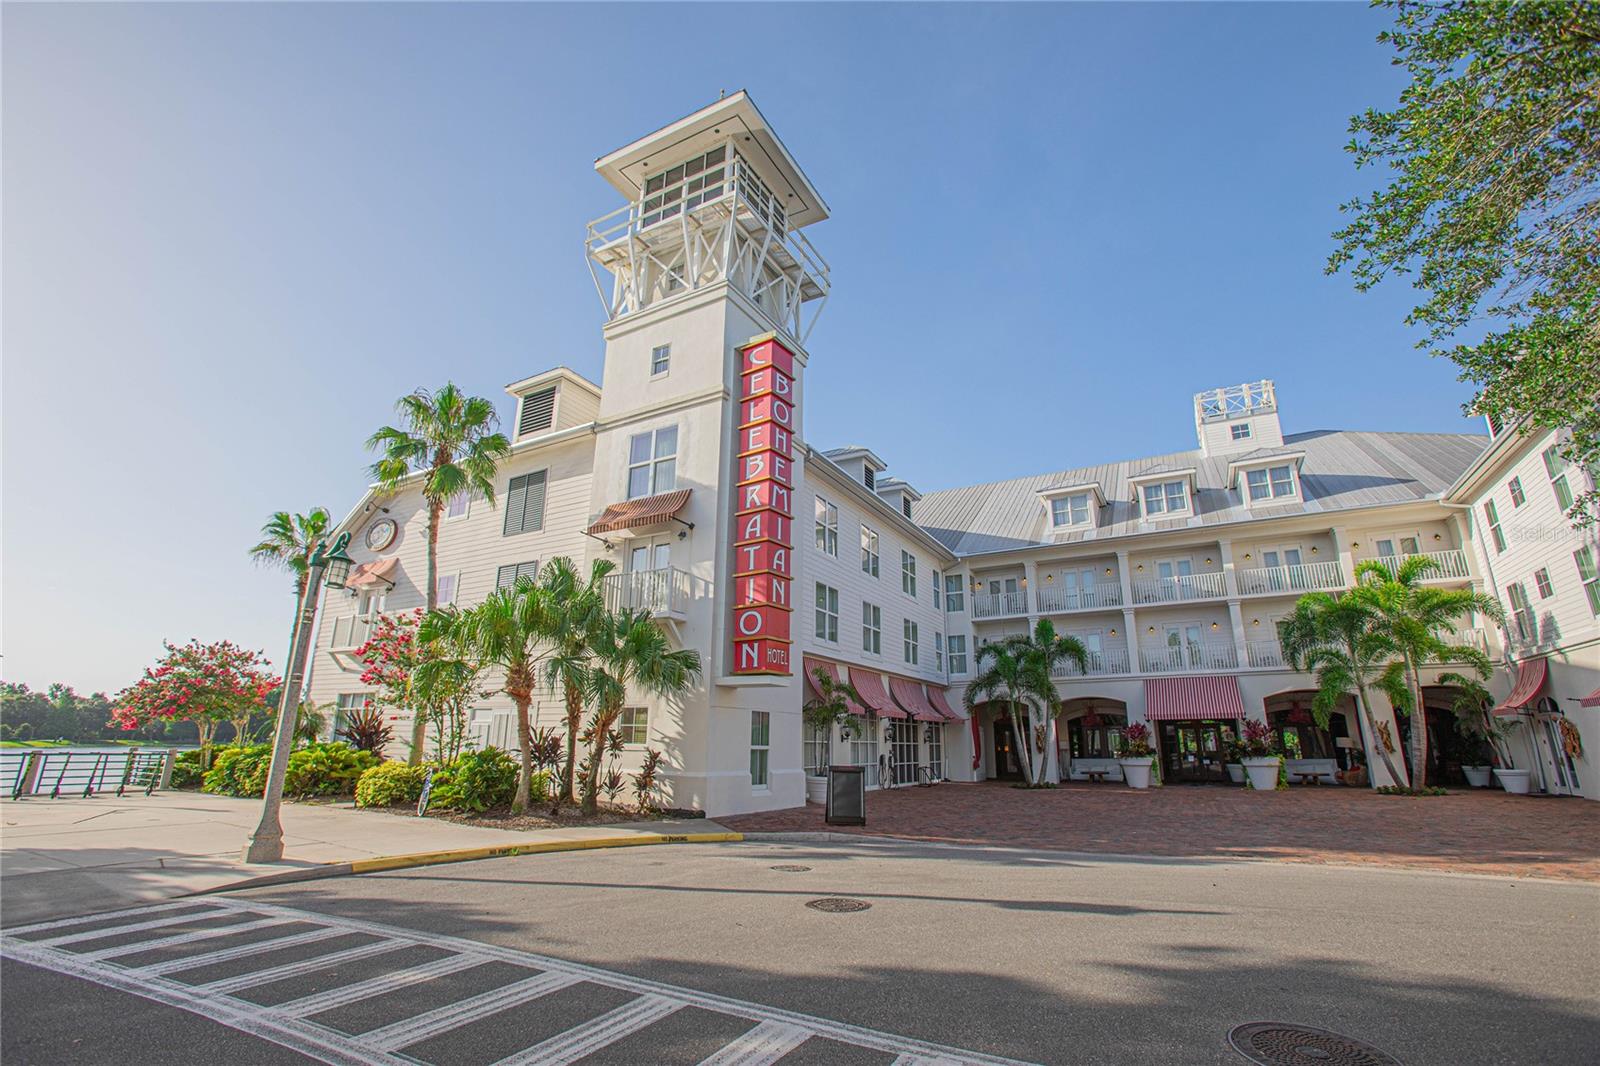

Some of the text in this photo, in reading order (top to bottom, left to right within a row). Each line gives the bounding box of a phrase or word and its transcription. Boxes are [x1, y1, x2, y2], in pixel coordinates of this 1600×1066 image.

[739, 346, 766, 669] CELEBRATION
[771, 372, 790, 605] BOHEMIAN
[767, 648, 788, 665] HOTEL
